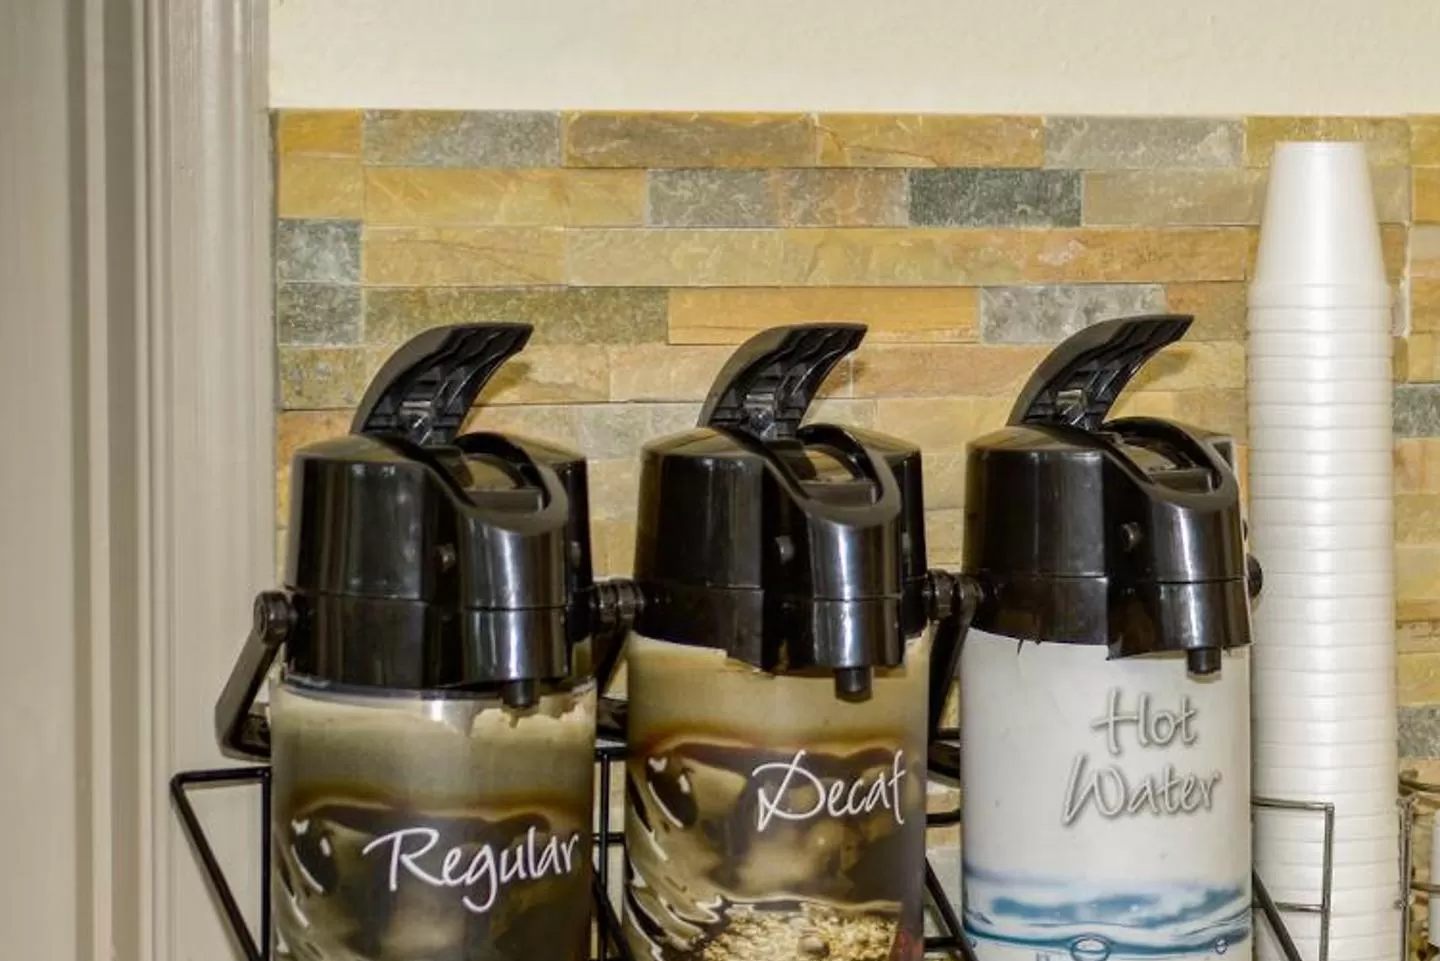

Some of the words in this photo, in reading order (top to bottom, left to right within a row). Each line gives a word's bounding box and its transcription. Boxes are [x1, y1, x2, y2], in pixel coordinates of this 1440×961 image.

[1091, 688, 1199, 754] Hot
[752, 749, 906, 832] Decaf
[1062, 755, 1221, 826] Water
[362, 827, 580, 912] Regular
